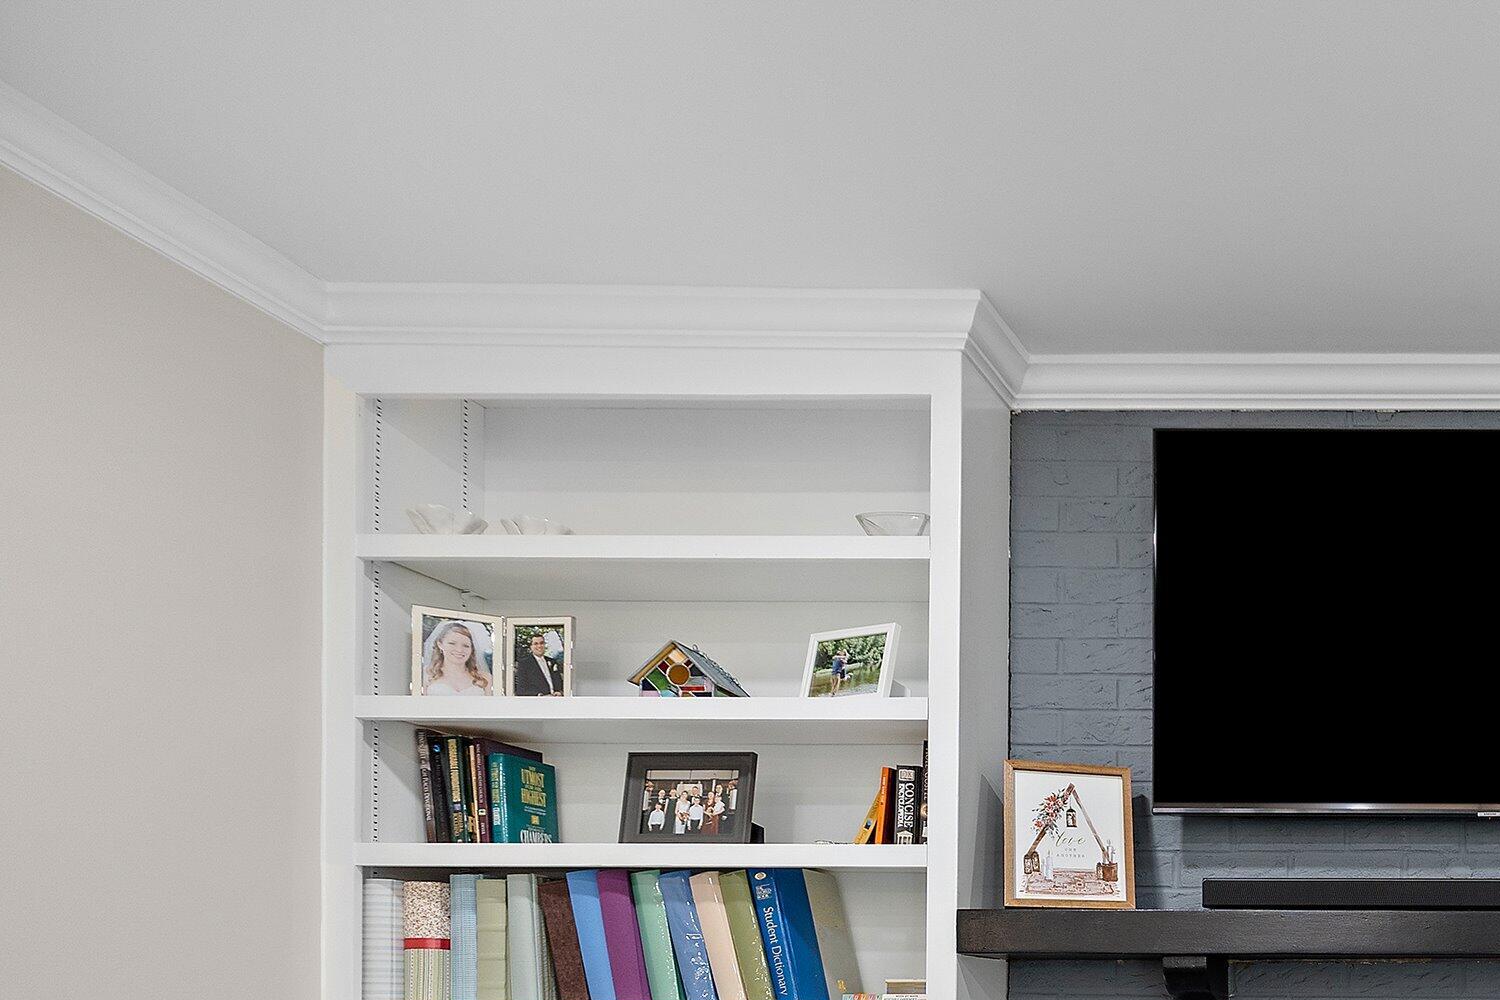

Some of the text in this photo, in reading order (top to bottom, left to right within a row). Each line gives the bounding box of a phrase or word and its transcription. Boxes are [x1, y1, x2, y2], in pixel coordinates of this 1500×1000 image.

[521, 768, 544, 788] UTMOST
[897, 783, 905, 828] ENCYCLOPEDIA
[904, 783, 915, 828] CONCISE
[762, 906, 778, 944] Student
[771, 946, 788, 995] Dictionary
